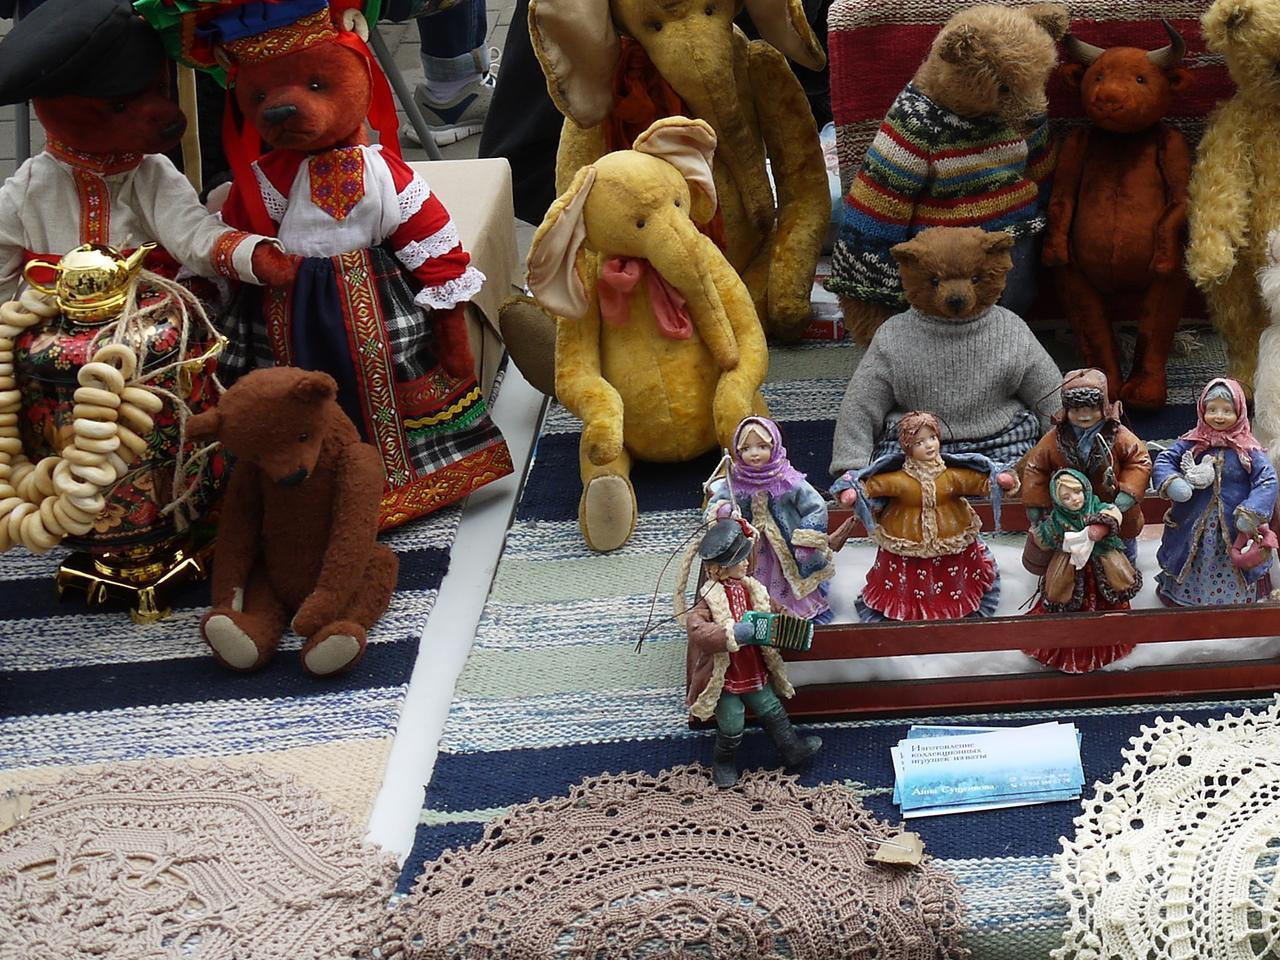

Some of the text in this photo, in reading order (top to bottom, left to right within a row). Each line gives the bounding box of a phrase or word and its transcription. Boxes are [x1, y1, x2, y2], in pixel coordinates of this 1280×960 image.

[911, 743, 975, 752] Изготовление
[911, 749, 982, 758] коллекционных
[911, 757, 950, 765] игрушек
